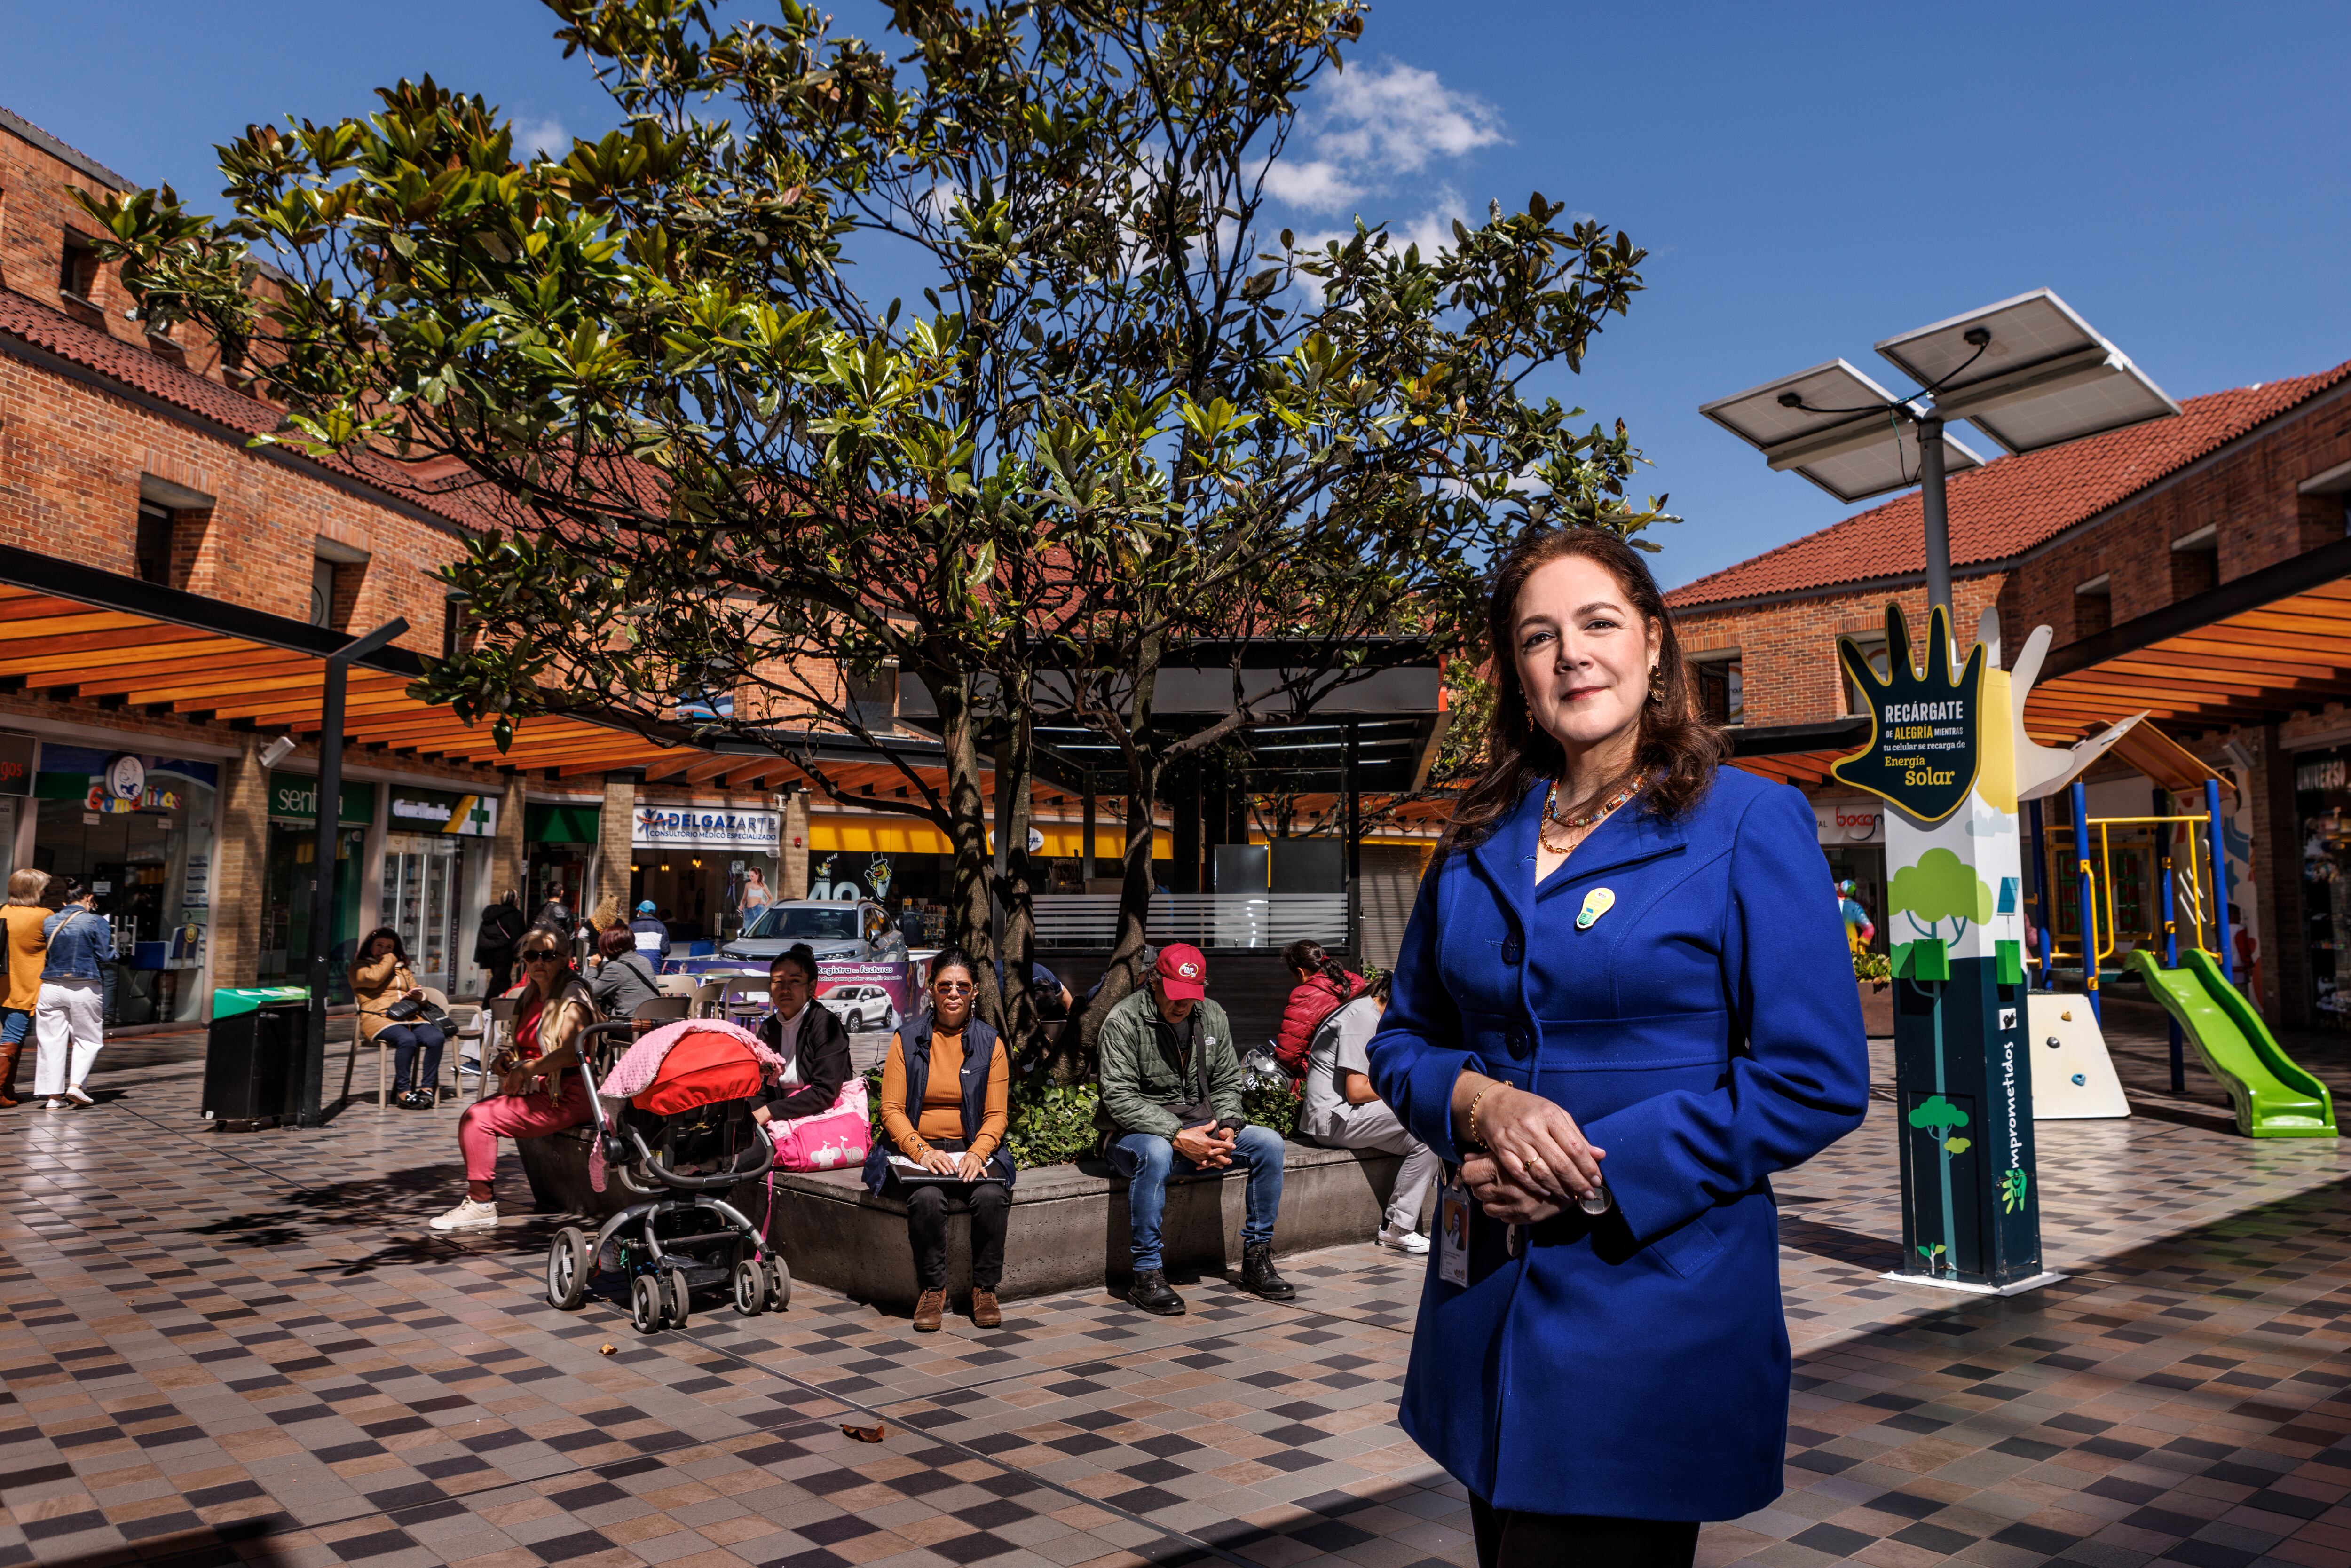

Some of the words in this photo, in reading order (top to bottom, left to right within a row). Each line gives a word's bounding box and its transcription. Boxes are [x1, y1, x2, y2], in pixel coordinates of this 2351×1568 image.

[1885, 701, 1963, 723] RECÁRGATE
[1894, 724, 1933, 740] ALEGRÍA
[1934, 727, 1963, 736] MIENTRAS
[1927, 742, 1955, 751] recarga
[1885, 755, 1925, 769] Energía
[86, 784, 181, 813] Gomelitos
[655, 812, 776, 830] ADELGAZARTE
[448, 918, 458, 989] DERMACENTER
[818, 966, 851, 976] Registra
[860, 965, 893, 974] facturas
